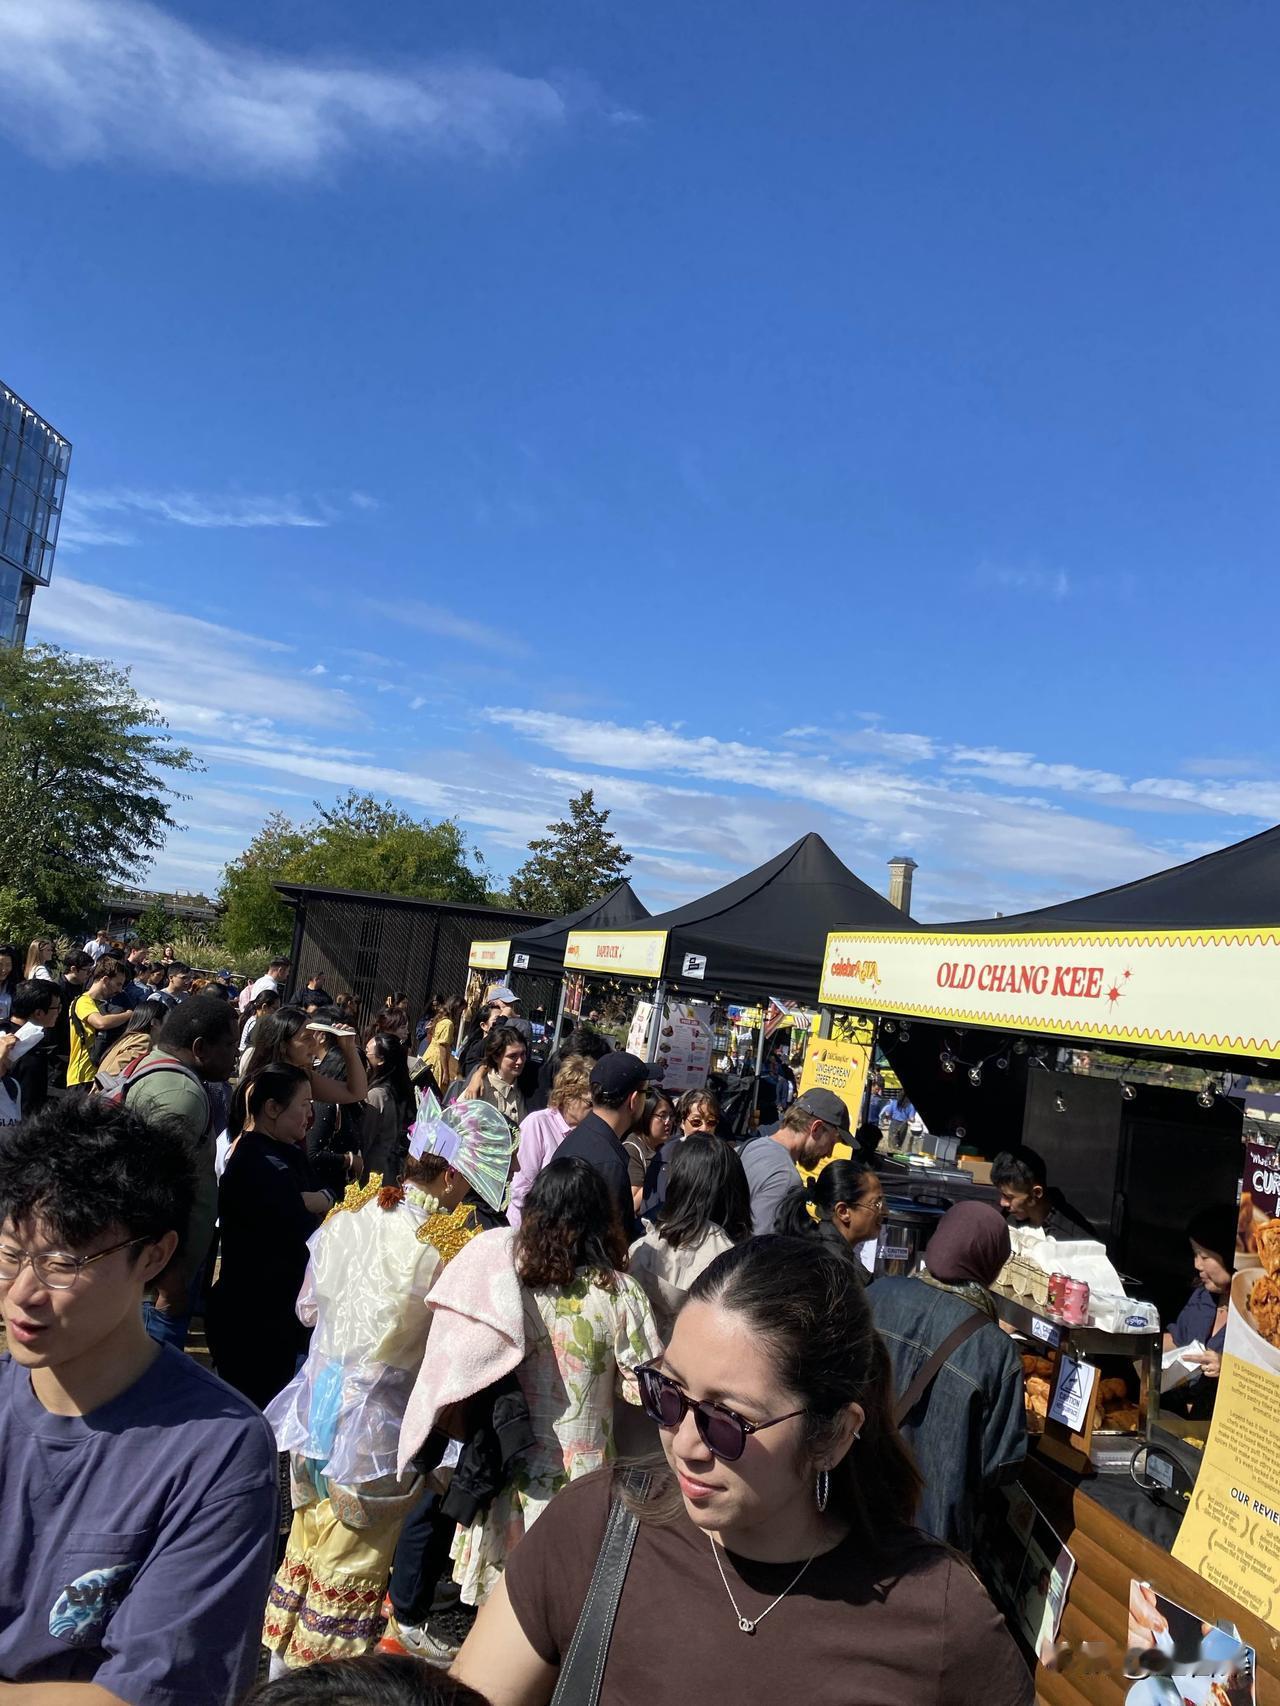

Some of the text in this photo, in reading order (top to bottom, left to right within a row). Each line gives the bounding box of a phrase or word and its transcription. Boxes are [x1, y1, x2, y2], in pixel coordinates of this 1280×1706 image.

[936, 962, 1104, 999] OLD CHANG KEE
[831, 1076, 847, 1089] FOOD
[1059, 1391, 1080, 1407] CAUTION
[1230, 1487, 1250, 1507] OUR
[1252, 1499, 1280, 1526] REVIE
